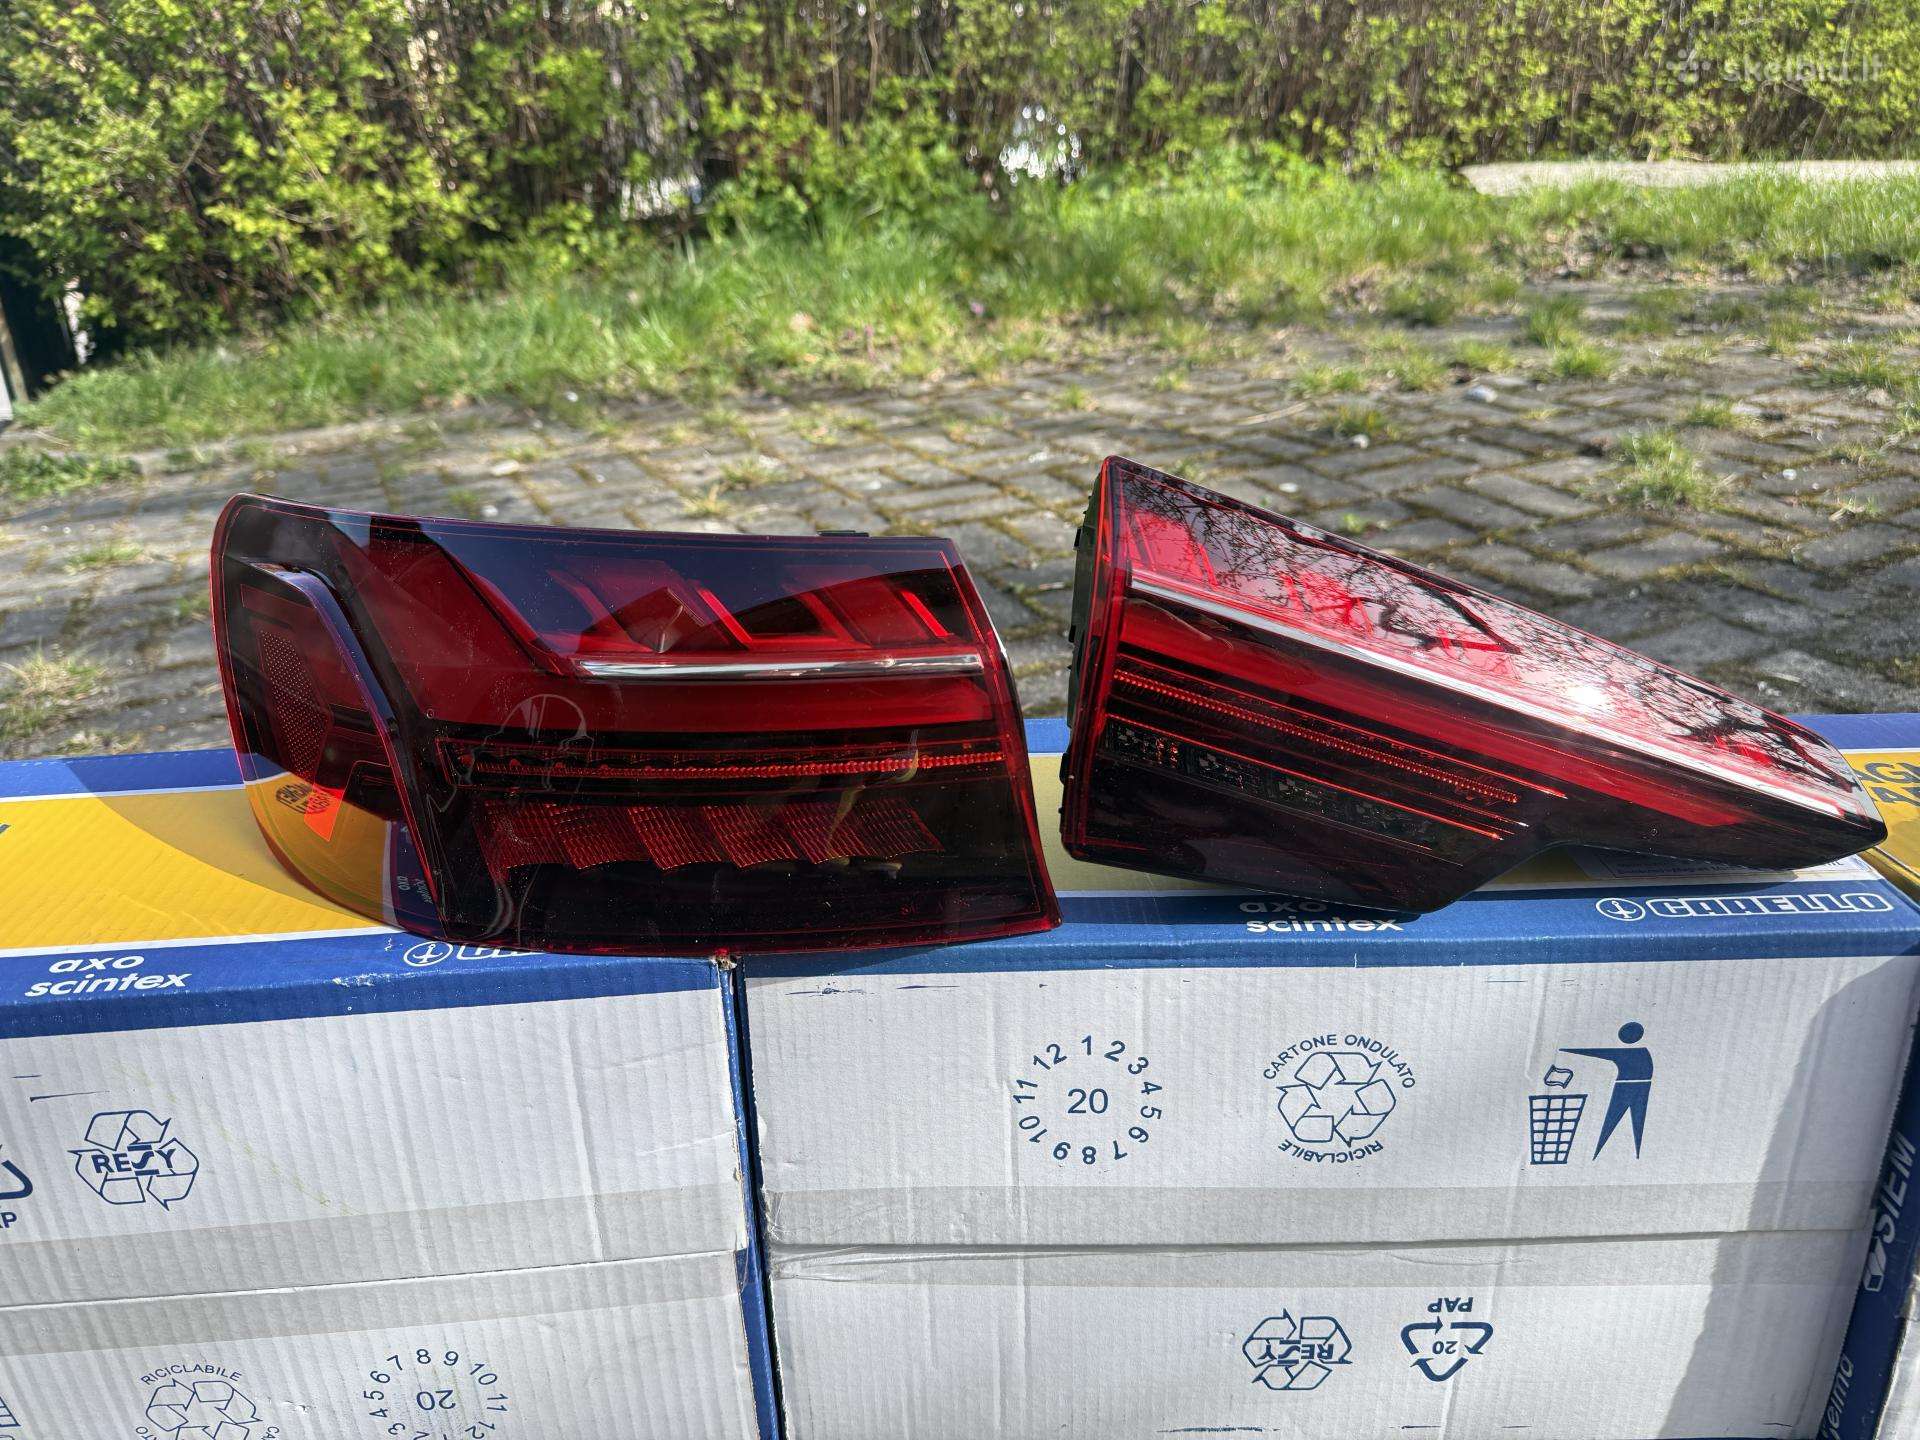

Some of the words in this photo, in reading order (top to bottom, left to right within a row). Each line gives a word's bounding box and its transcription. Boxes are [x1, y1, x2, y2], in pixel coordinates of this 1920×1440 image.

[1239, 901, 1328, 913] axo
[1645, 892, 1894, 918] CARELLO
[1246, 915, 1404, 933] scintex
[48, 955, 145, 973] axo
[24, 972, 193, 997] scintex
[1081, 1035, 1092, 1056] 1
[1104, 1040, 1126, 1062] 2
[1033, 1043, 1067, 1071] 12
[1127, 1056, 1149, 1075] 3
[1263, 1034, 1338, 1080] CARTONE
[1344, 1034, 1416, 1089] ONDULATO
[1013, 1079, 1038, 1104] 11
[1141, 1081, 1163, 1095] 4
[1067, 1088, 1109, 1114] 20
[1140, 1105, 1162, 1120] 5
[1018, 1115, 1048, 1143] 10
[1081, 1146, 1097, 1165] 8
[1113, 1140, 1128, 1160] 7
[1278, 1139, 1384, 1164] RICICLABILE
[1874, 1130, 1917, 1244] SIEM
[0, 1211, 17, 1229] P
[1427, 1296, 1474, 1313] PAP
[416, 1348, 431, 1364] 8
[1431, 1340, 1458, 1355] 20
[386, 1354, 403, 1371] 7
[443, 1351, 459, 1366] 9
[141, 1364, 242, 1386] RICICLABILE
[370, 1370, 391, 1384] 6
[470, 1362, 498, 1386] 10
[363, 1390, 385, 1401] 5
[416, 1389, 456, 1411] 20
[487, 1393, 509, 1412] 11
[369, 1407, 388, 1418] 4
[388, 1422, 406, 1436] 3
[465, 1421, 496, 1440] 12
